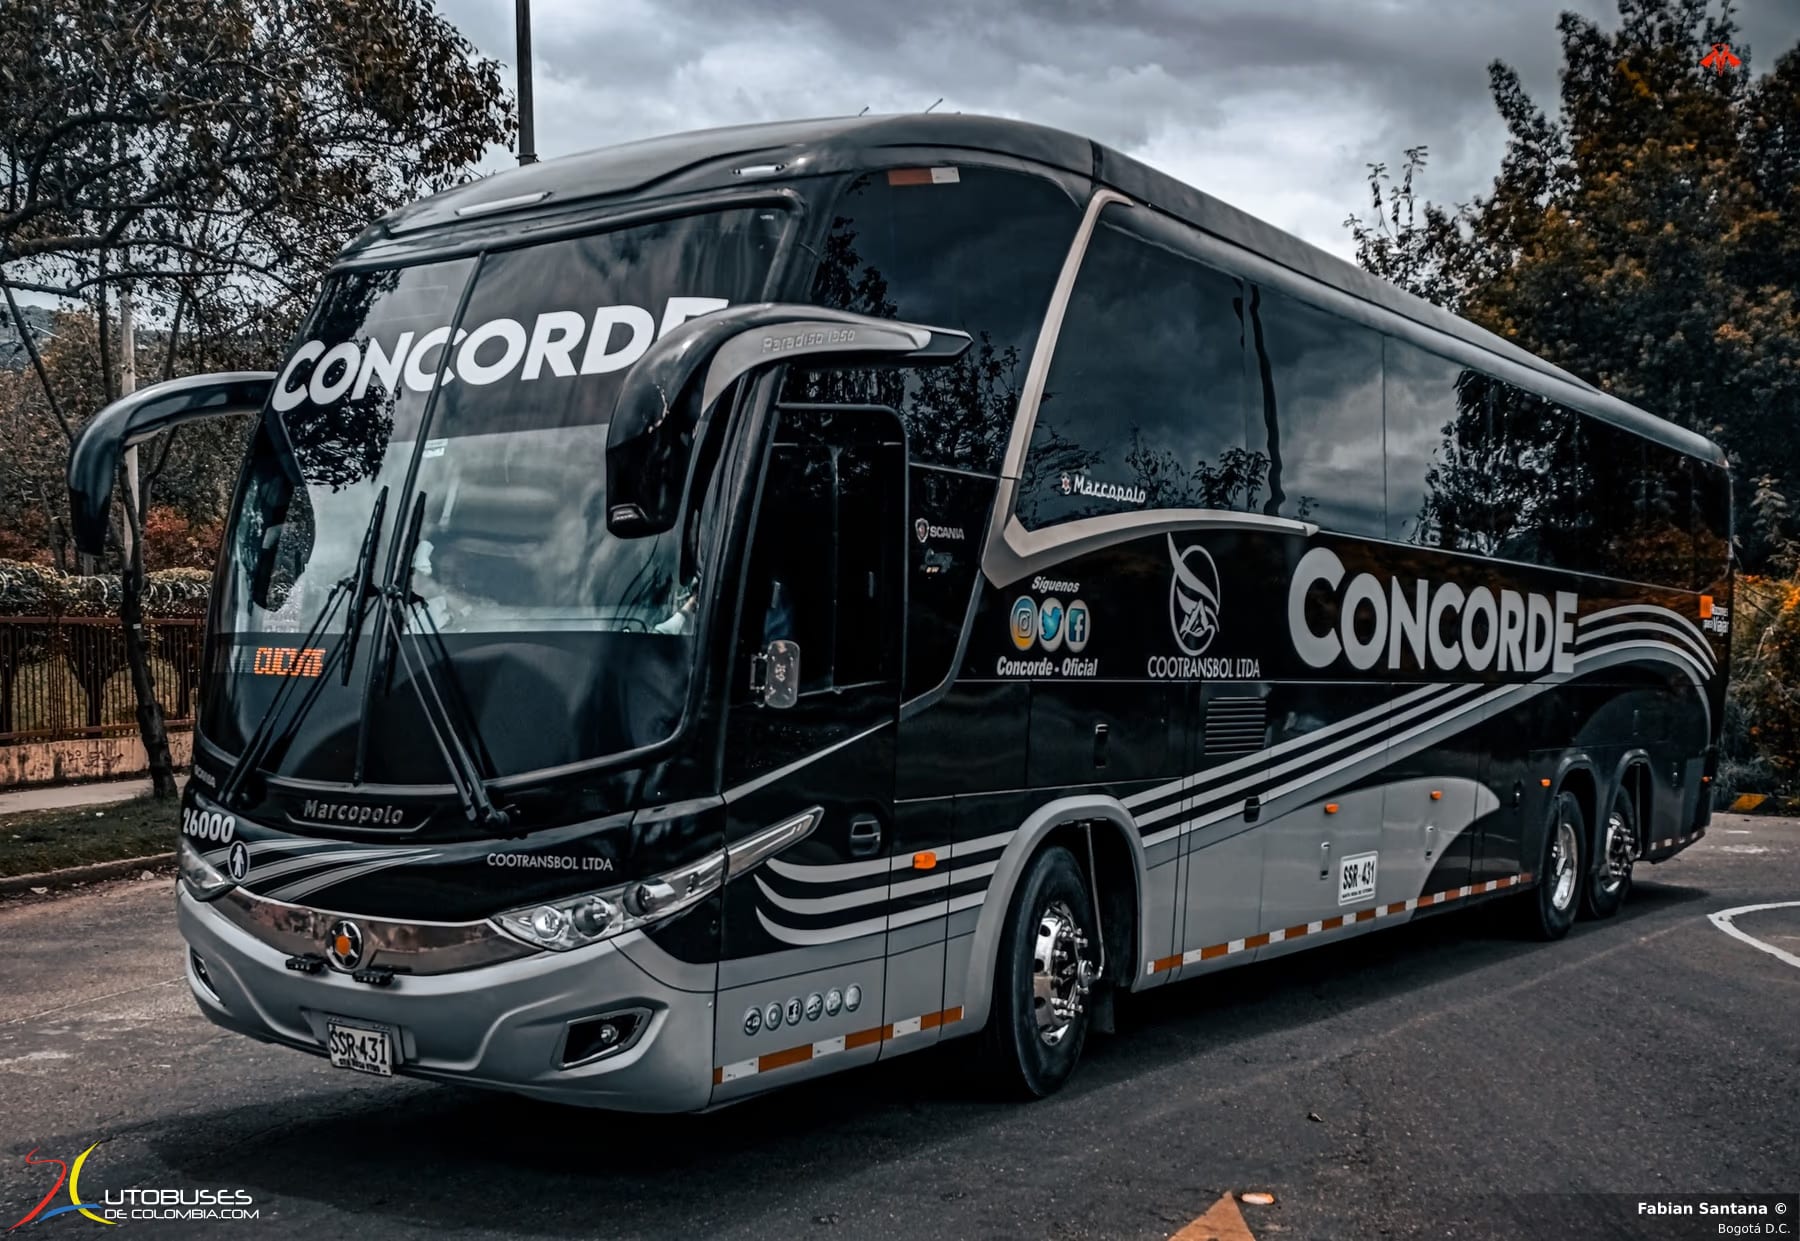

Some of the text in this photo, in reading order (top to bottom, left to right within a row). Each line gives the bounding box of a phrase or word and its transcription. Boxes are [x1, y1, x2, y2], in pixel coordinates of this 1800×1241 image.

[762, 332, 824, 353] Paradiso
[1073, 473, 1146, 503] Marcopolo
[929, 525, 965, 540] SCANIA
[1288, 547, 1578, 674] CONCORDE
[997, 656, 1053, 676] Concorde
[1062, 657, 1099, 676] Oficial
[1147, 656, 1261, 678] COOTRANSBOL LTDA
[303, 799, 404, 824] Marcopolo
[182, 807, 236, 844] 26000
[486, 852, 614, 871] COOTRANSBOL LTDA
